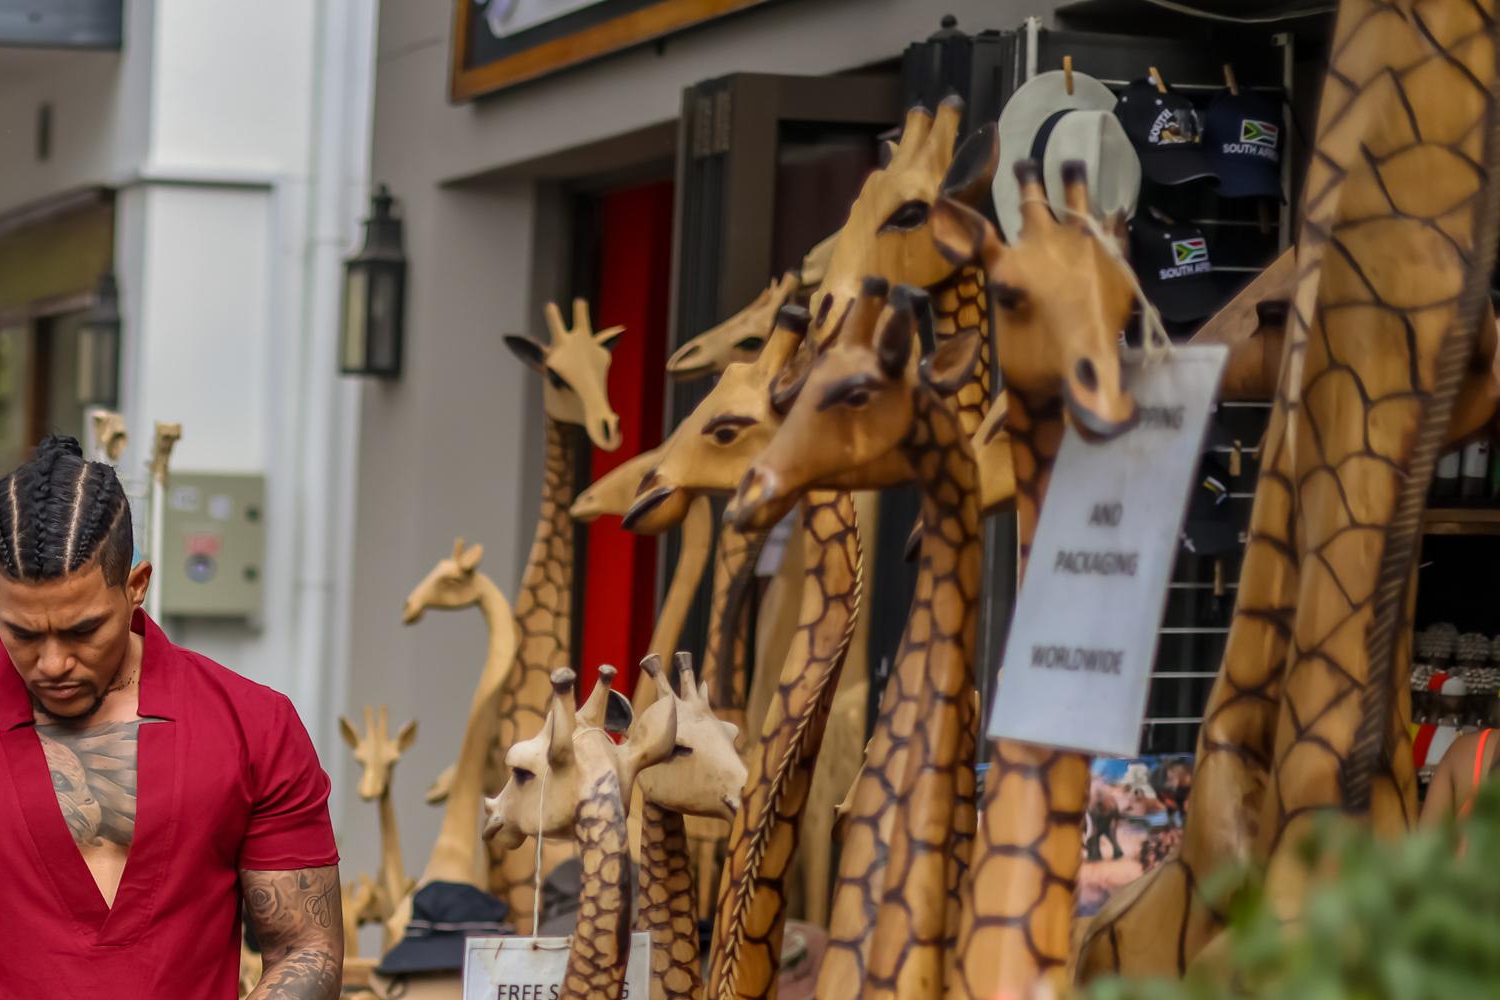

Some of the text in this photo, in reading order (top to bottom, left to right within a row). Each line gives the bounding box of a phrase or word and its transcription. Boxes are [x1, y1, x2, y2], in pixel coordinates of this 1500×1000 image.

[1222, 143, 1257, 155] SOUTH
[1159, 263, 1194, 280] SOUTH
[1088, 502, 1124, 528] AND
[1054, 550, 1140, 577] PACKAGING
[1030, 645, 1125, 675] WORLDWIDE
